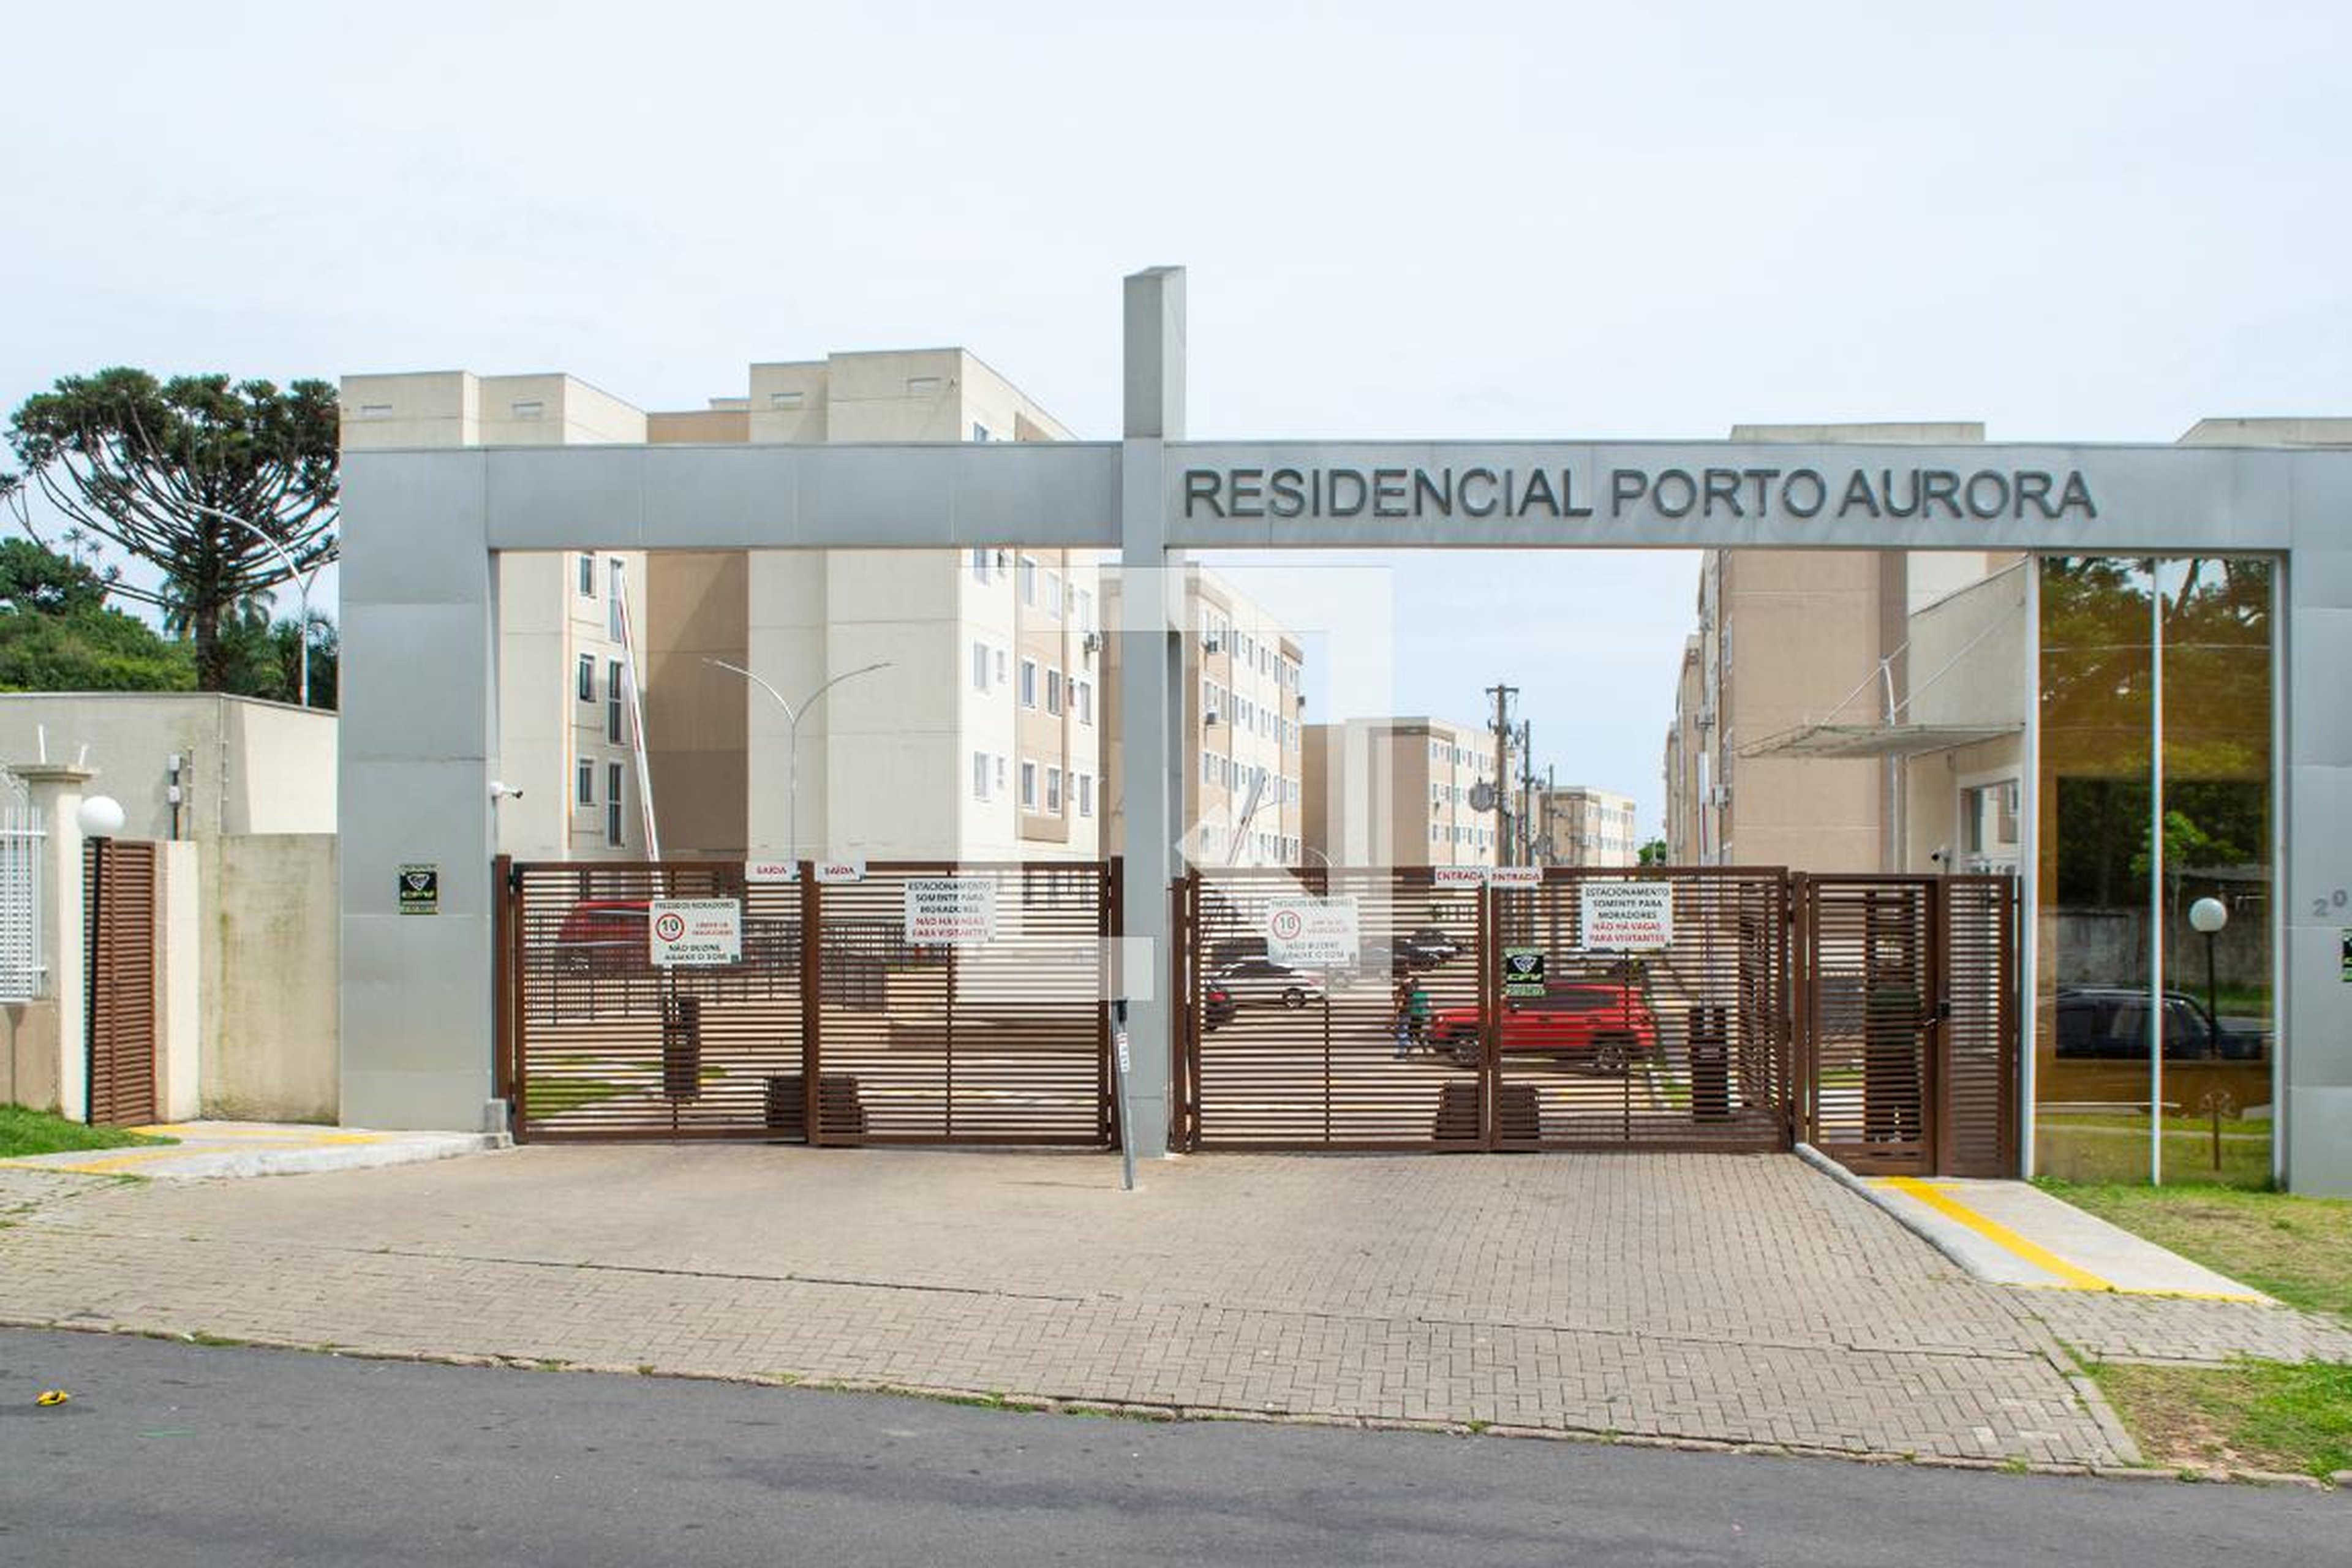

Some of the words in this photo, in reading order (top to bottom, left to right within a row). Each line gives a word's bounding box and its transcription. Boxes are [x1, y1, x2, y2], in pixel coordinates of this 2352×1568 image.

[1185, 469, 1593, 518] RESIDENCIAL
[1611, 469, 1826, 518] PORTO
[1838, 469, 2097, 519] AURORA
[1437, 871, 1485, 881] ENTRADA
[1491, 872, 1540, 881] ENTRADA
[908, 881, 991, 890] ESTACIONAMENTO
[662, 919, 679, 932] 10
[1280, 917, 1296, 929] 10
[1593, 921, 1614, 930] NÃO
